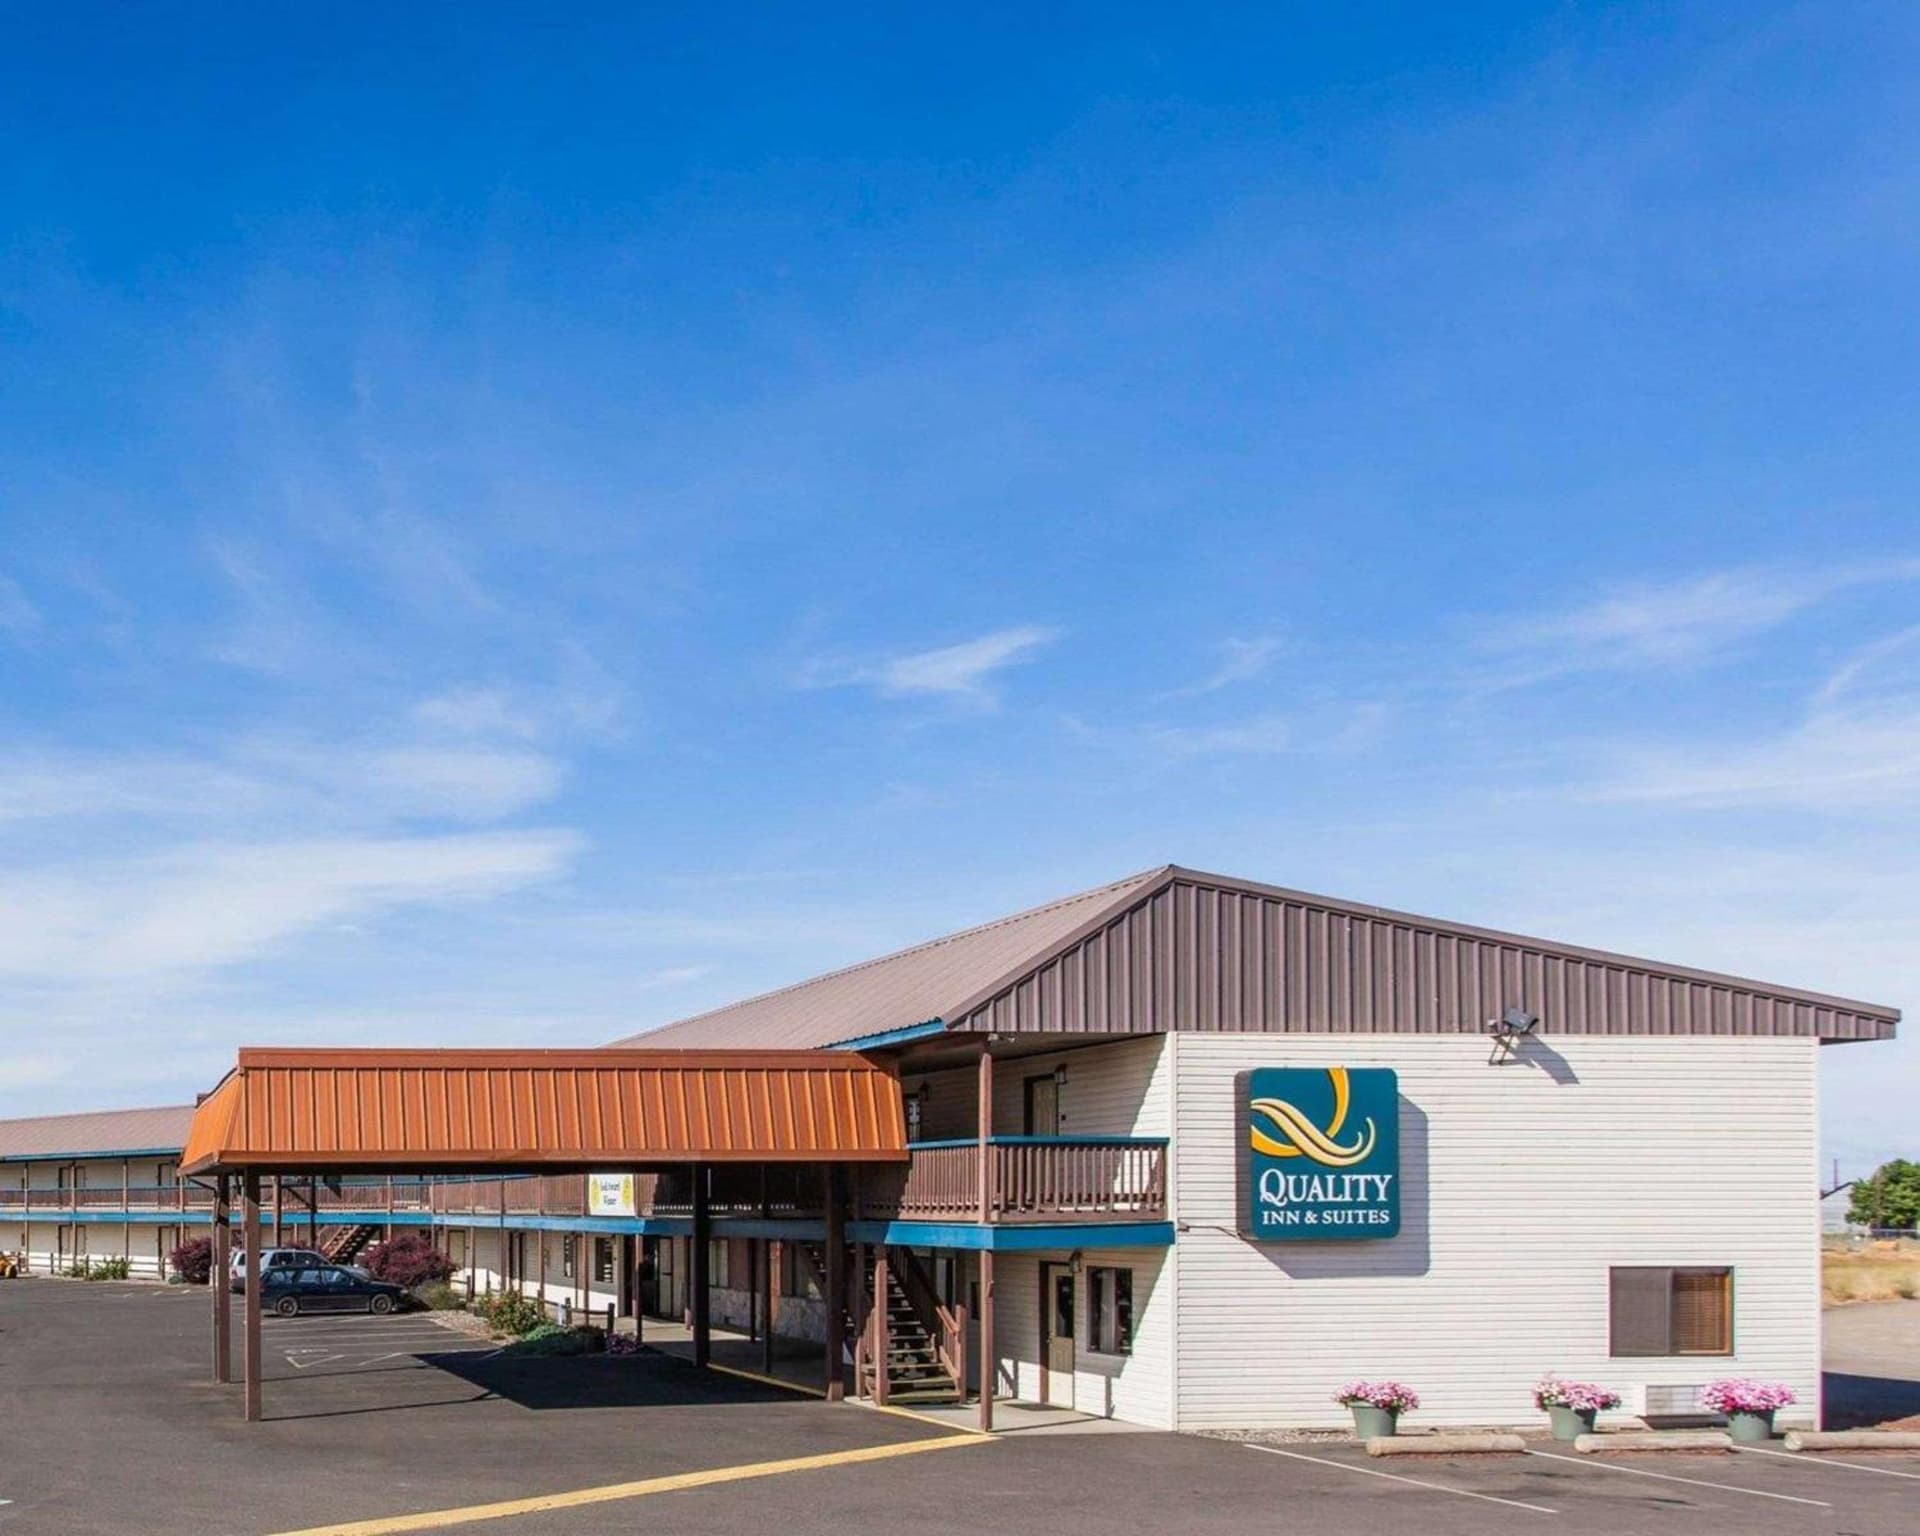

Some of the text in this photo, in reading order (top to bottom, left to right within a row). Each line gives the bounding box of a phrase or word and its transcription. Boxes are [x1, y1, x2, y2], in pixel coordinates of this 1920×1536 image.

[1259, 1168, 1392, 1206] QUALITY
[1262, 1209, 1390, 1224] INN & SUITES
